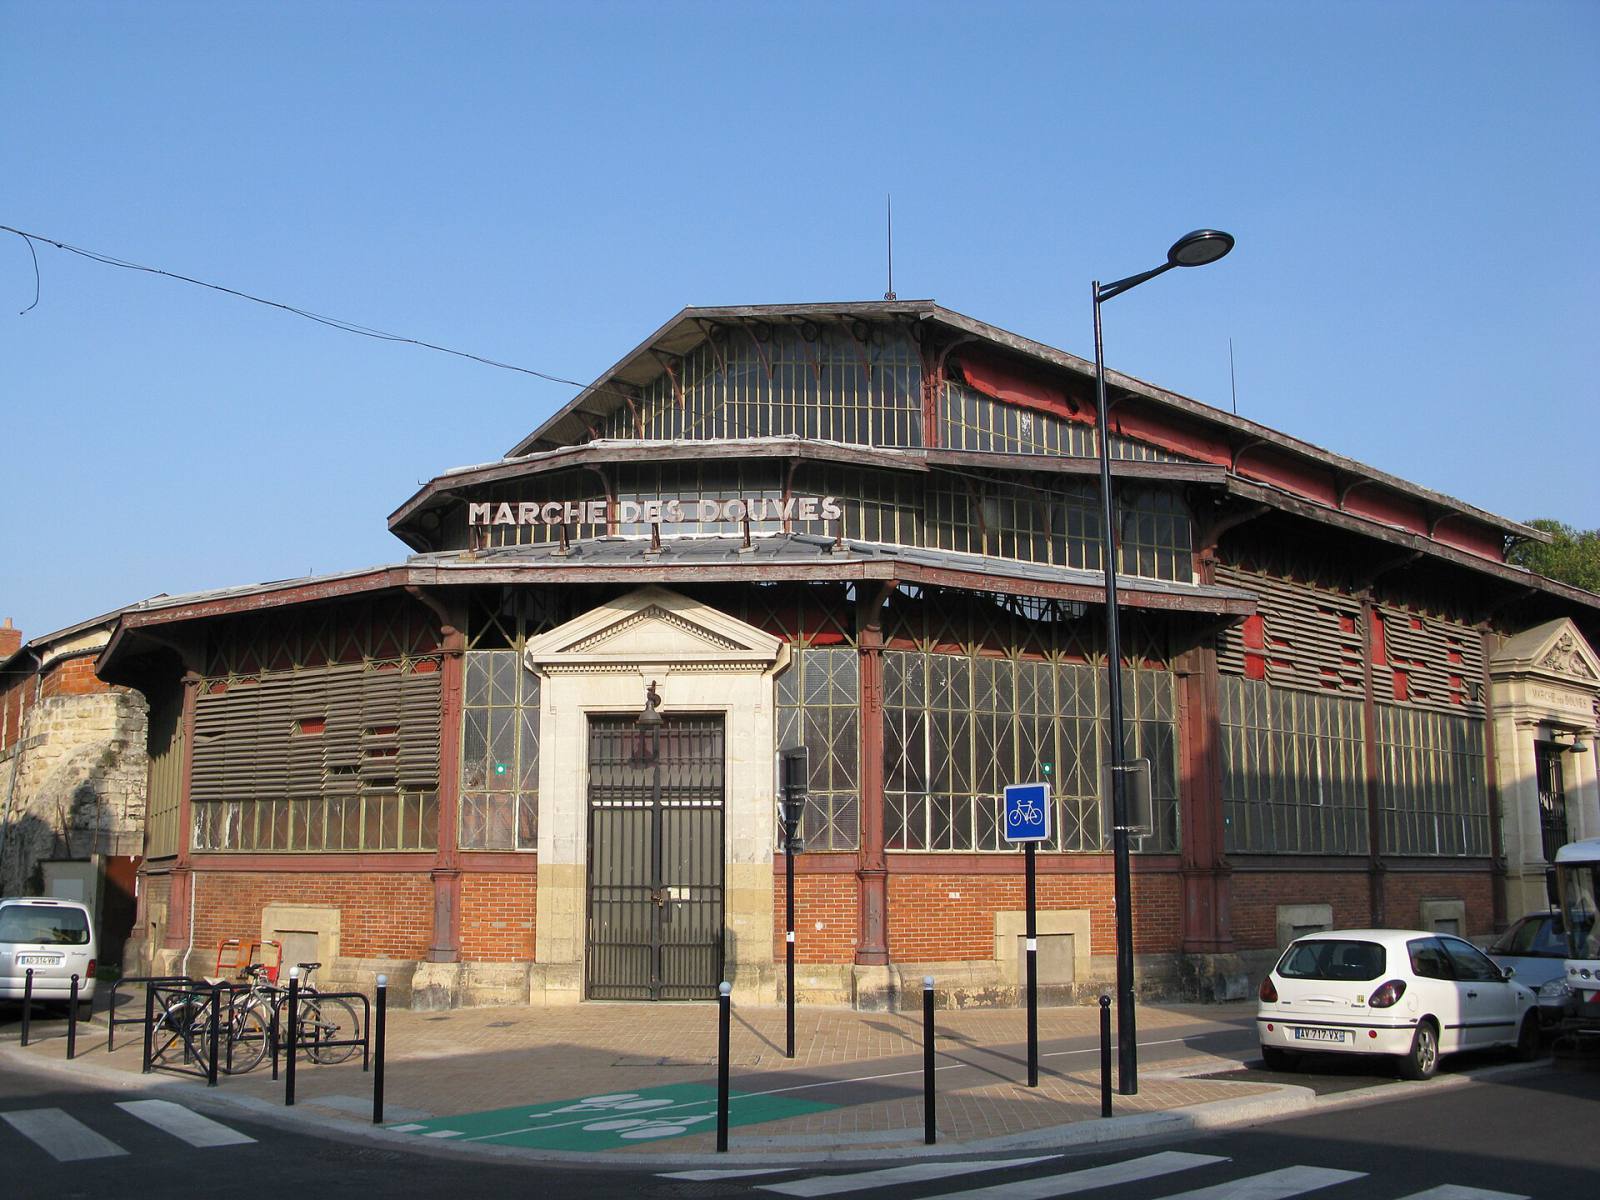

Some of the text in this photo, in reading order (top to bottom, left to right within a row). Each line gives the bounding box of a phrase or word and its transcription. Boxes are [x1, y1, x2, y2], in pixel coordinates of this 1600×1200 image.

[468, 496, 841, 525] MARCHE DES DOUVES
